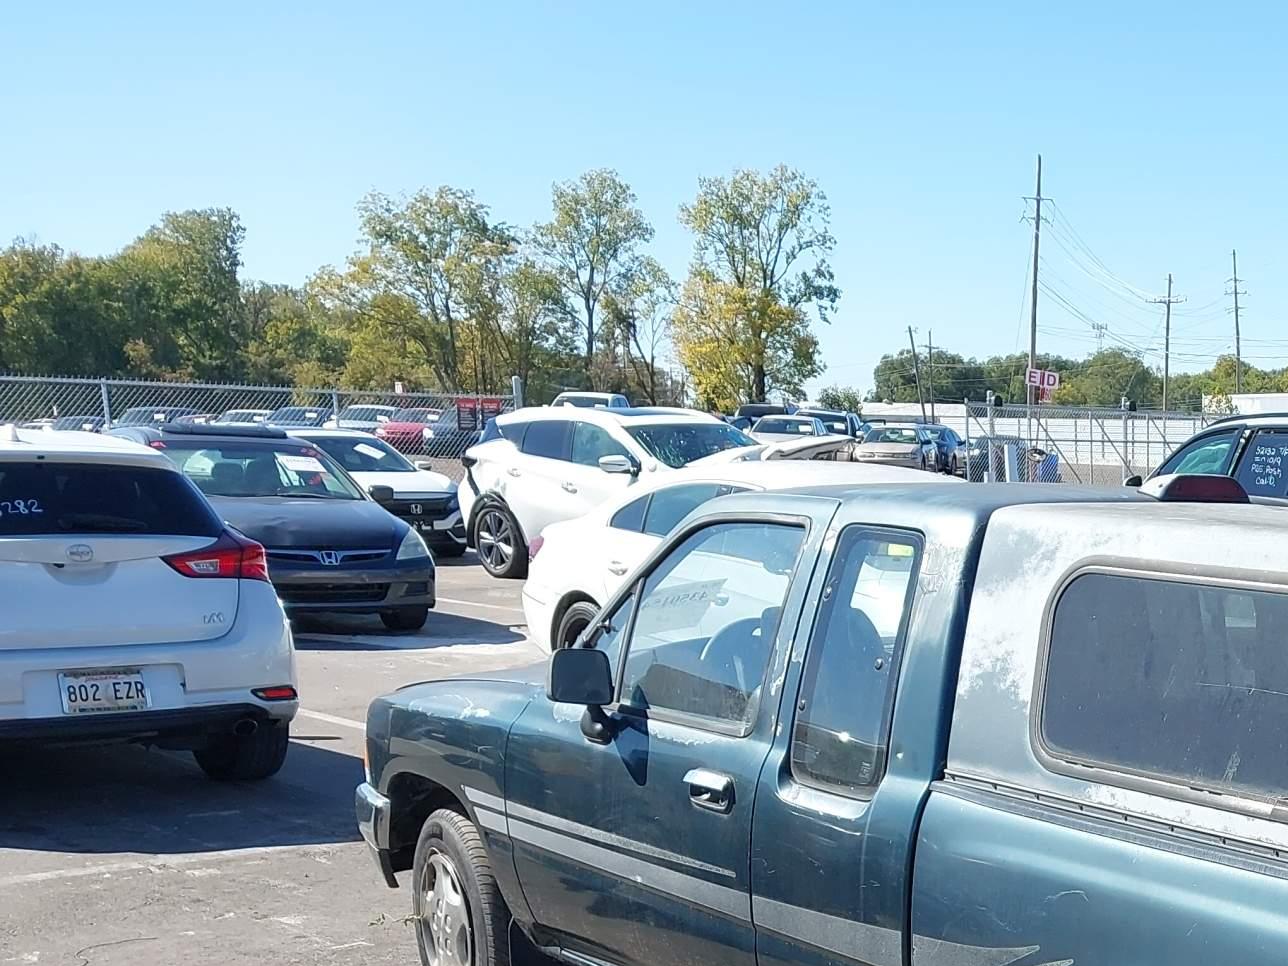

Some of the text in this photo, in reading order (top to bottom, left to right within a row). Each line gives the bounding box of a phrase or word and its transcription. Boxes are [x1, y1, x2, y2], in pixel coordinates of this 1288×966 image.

[0, 499, 43, 517] 282
[67, 681, 145, 703] 802 EZR
